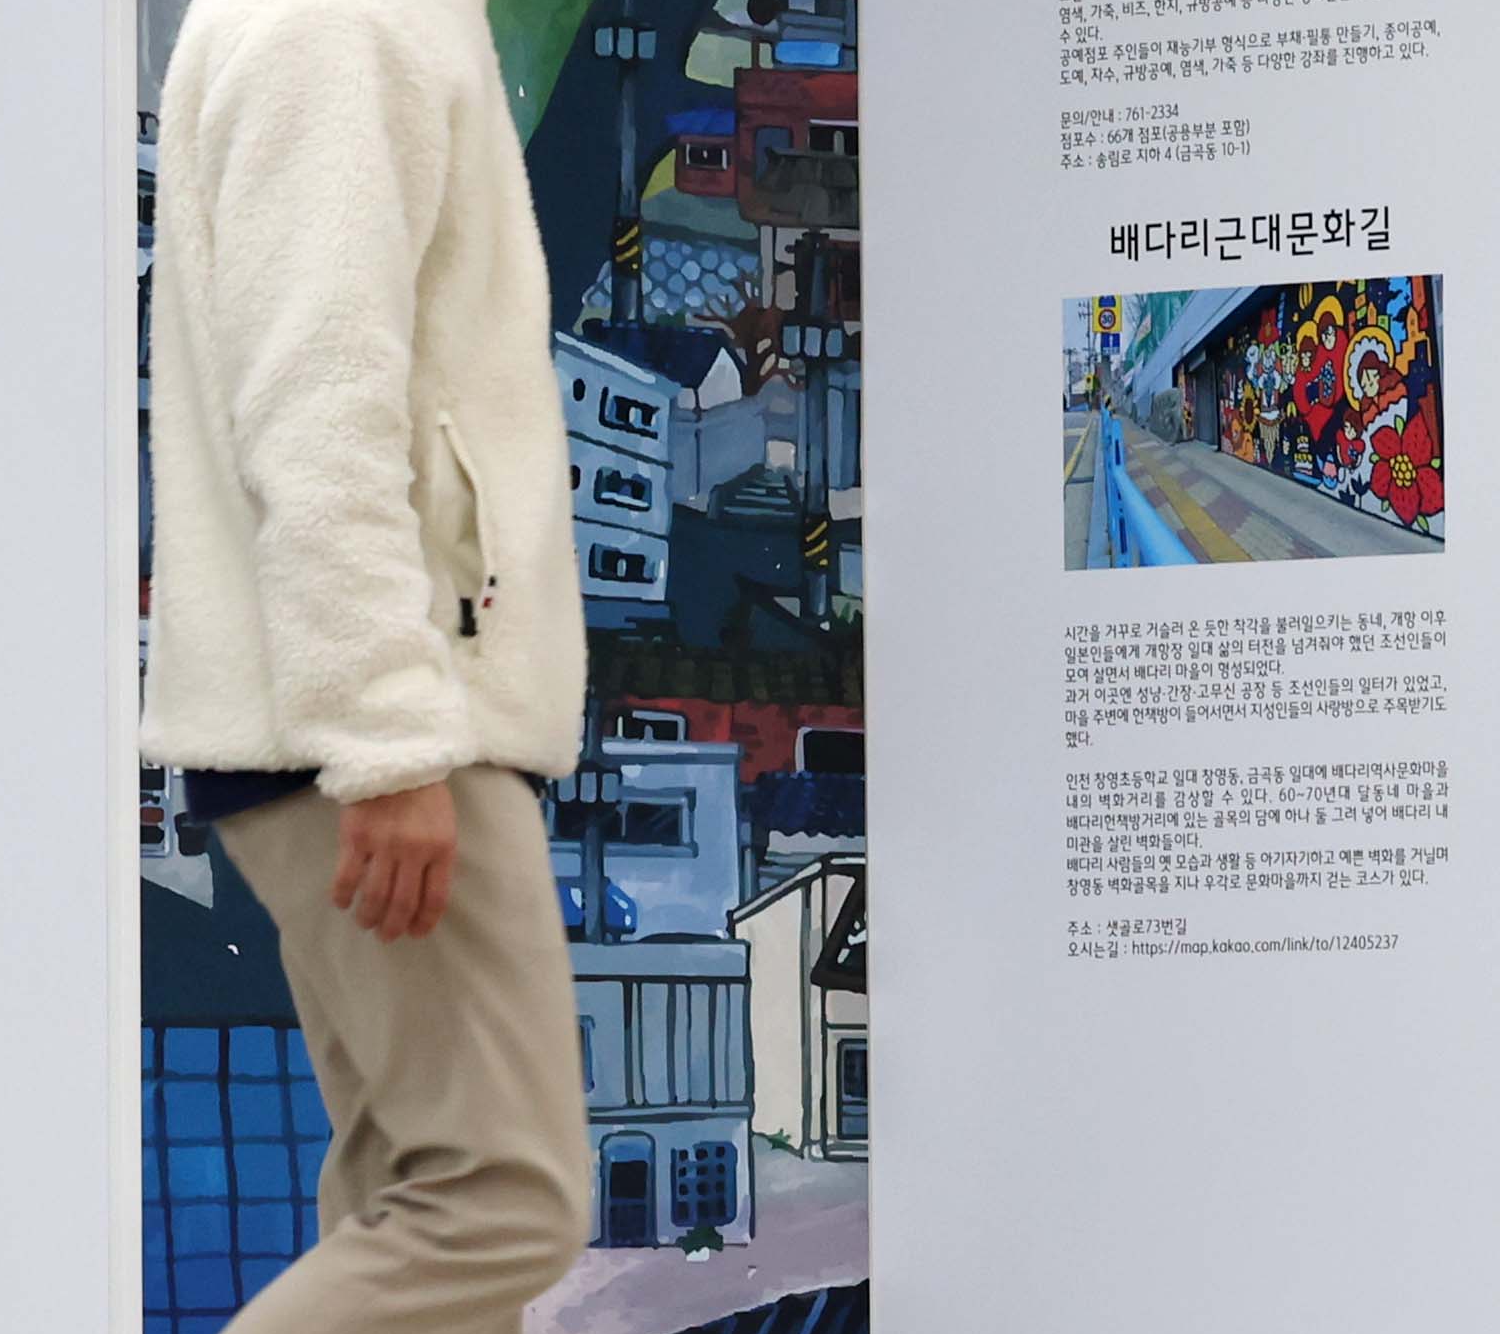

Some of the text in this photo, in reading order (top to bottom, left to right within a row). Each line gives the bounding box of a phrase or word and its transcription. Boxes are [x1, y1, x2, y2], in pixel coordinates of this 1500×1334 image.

[1060, 107, 1114, 130] 문의/안내
[1123, 102, 1179, 122] 761-2334
[1110, 205, 1390, 262] 배다리근대문화길
[1065, 609, 1446, 645] 시간을 거꾸로 거슬러 온 듯한 착각을 불러일으키는 동네, 개항 이후
[1066, 760, 1448, 792] 인천 창영초등학교 일대 창영동, 금곡동 일대에 배다리역사문화마을
[1068, 940, 1118, 959] 오시는길
